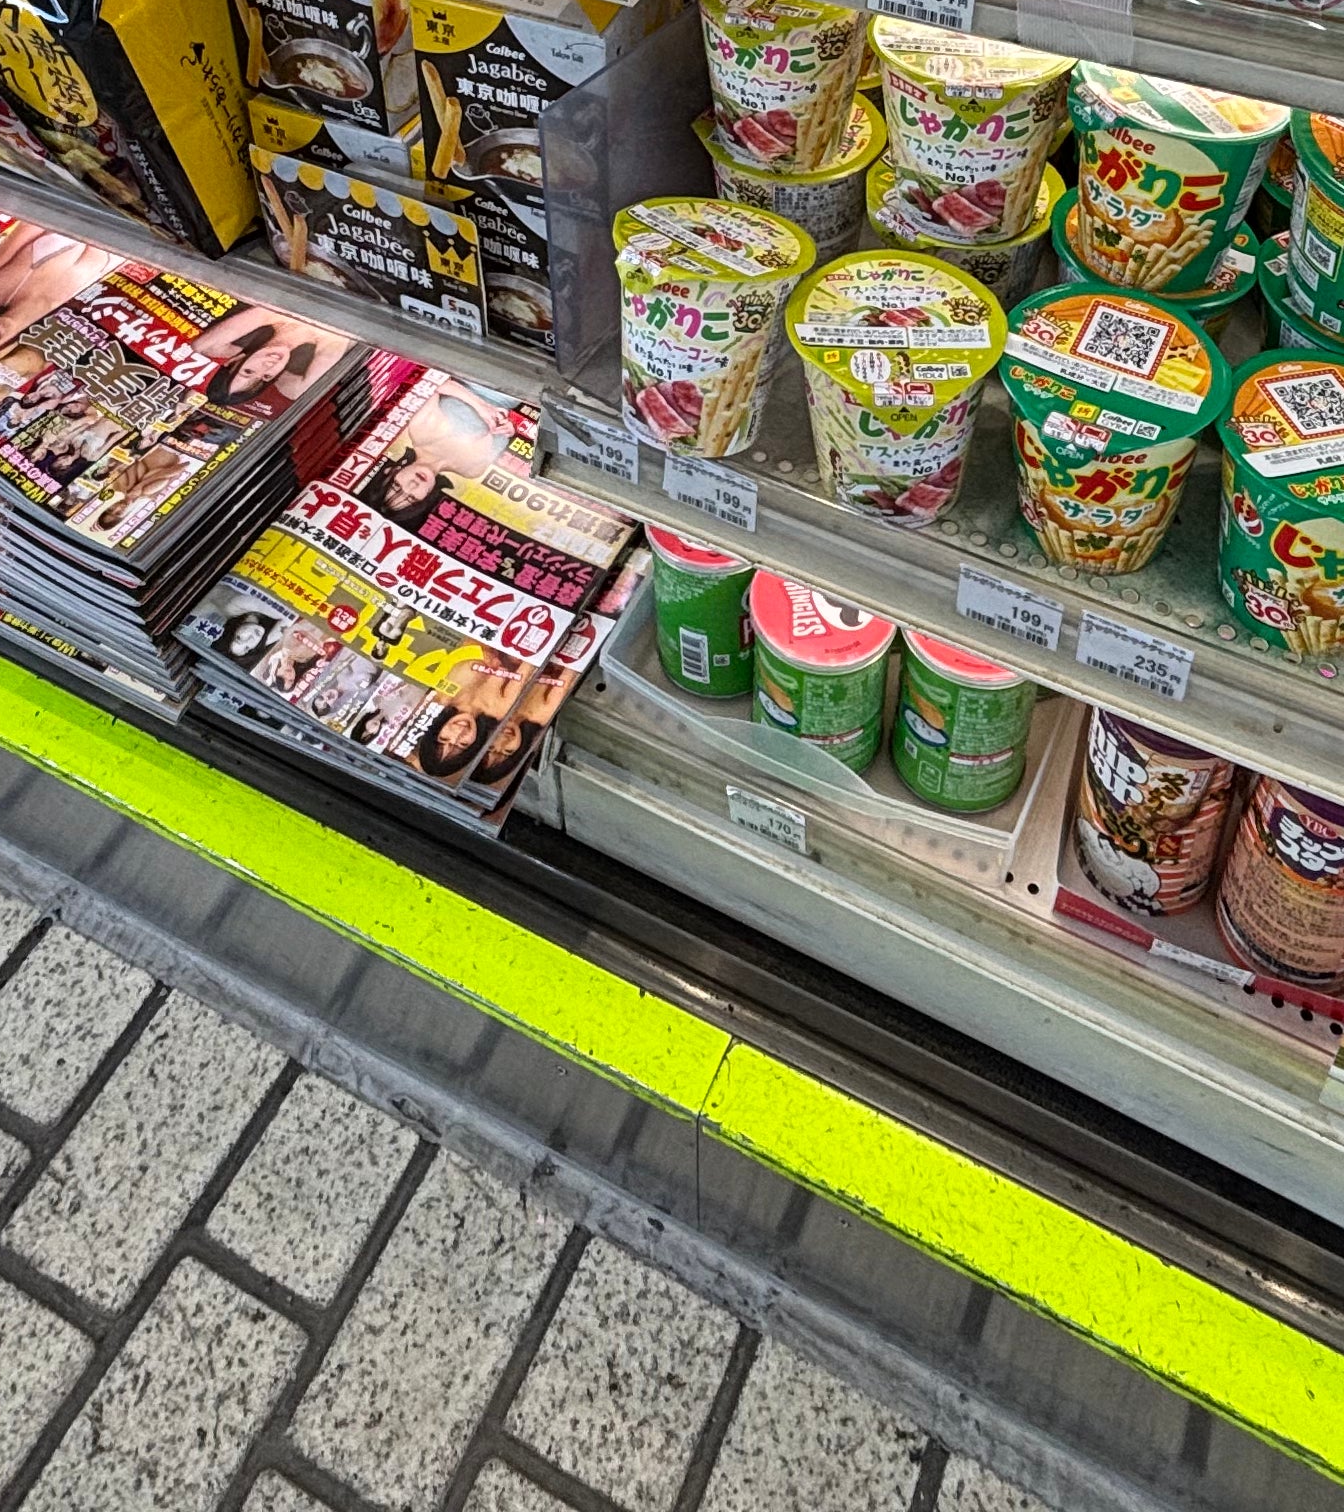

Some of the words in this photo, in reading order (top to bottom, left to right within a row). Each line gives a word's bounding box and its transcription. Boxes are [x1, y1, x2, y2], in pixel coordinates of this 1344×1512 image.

[702, 29, 819, 72] じゃがりこ
[740, 95, 768, 112] No.1
[898, 98, 1033, 143] じゃがりこ
[342, 203, 393, 231] Calbee
[1085, 178, 1168, 228] サラダ
[327, 213, 416, 262] Jagabee
[856, 268, 925, 284] じゃがりこ
[890, 410, 919, 423] OPEN
[1057, 498, 1153, 528] サラダ
[1010, 603, 1056, 637] 199円
[1133, 652, 1183, 685] 235円
[1301, 817, 1337, 838] YBC
